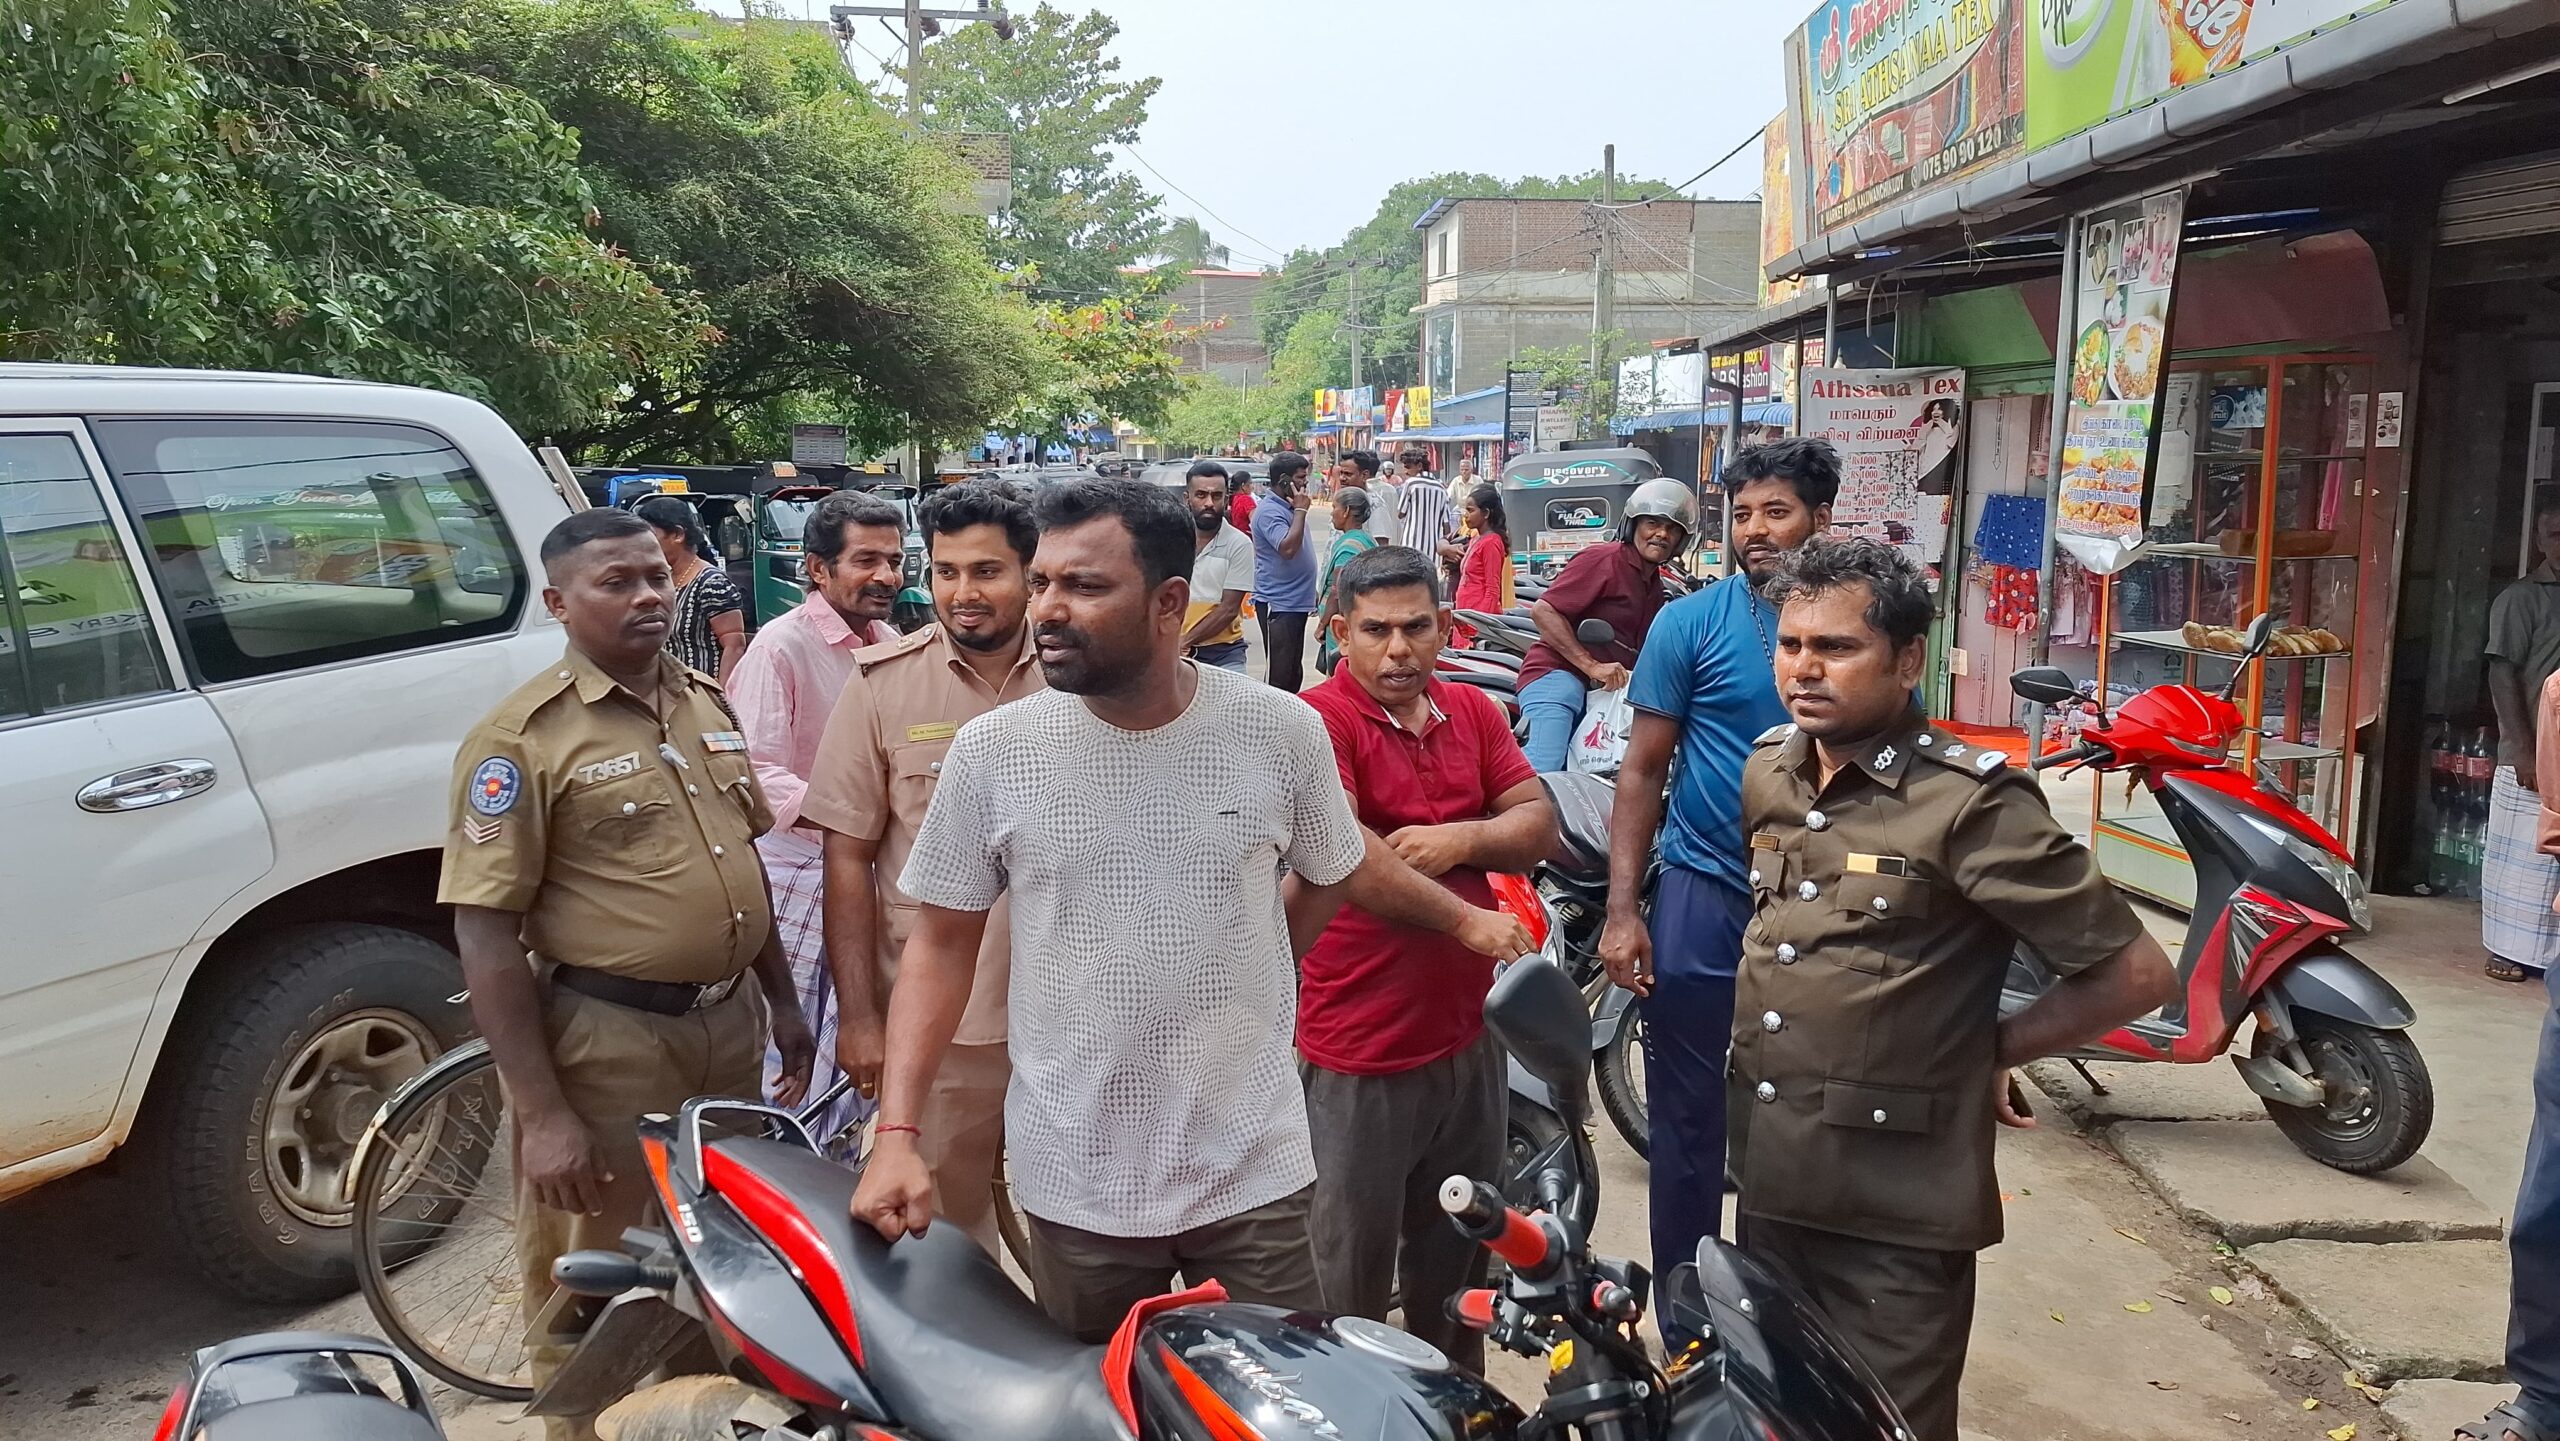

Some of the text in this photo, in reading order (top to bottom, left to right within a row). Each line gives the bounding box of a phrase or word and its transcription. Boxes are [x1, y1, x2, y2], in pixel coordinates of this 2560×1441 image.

[1834, 80, 1857, 131] SRI
[1859, 15, 1948, 112] ATHSANAA
[1951, 0, 1995, 53] TEX
[1923, 157, 1941, 181] 075
[1943, 148, 1958, 173] 90
[1977, 125, 2001, 157] 120
[1810, 375, 1960, 399] Athsana Tex
[1830, 405, 1897, 422] மாபெரும்
[1856, 425, 1920, 444] விற்பனை
[578, 751, 641, 784] T3657
[675, 1203, 704, 1244] 150
